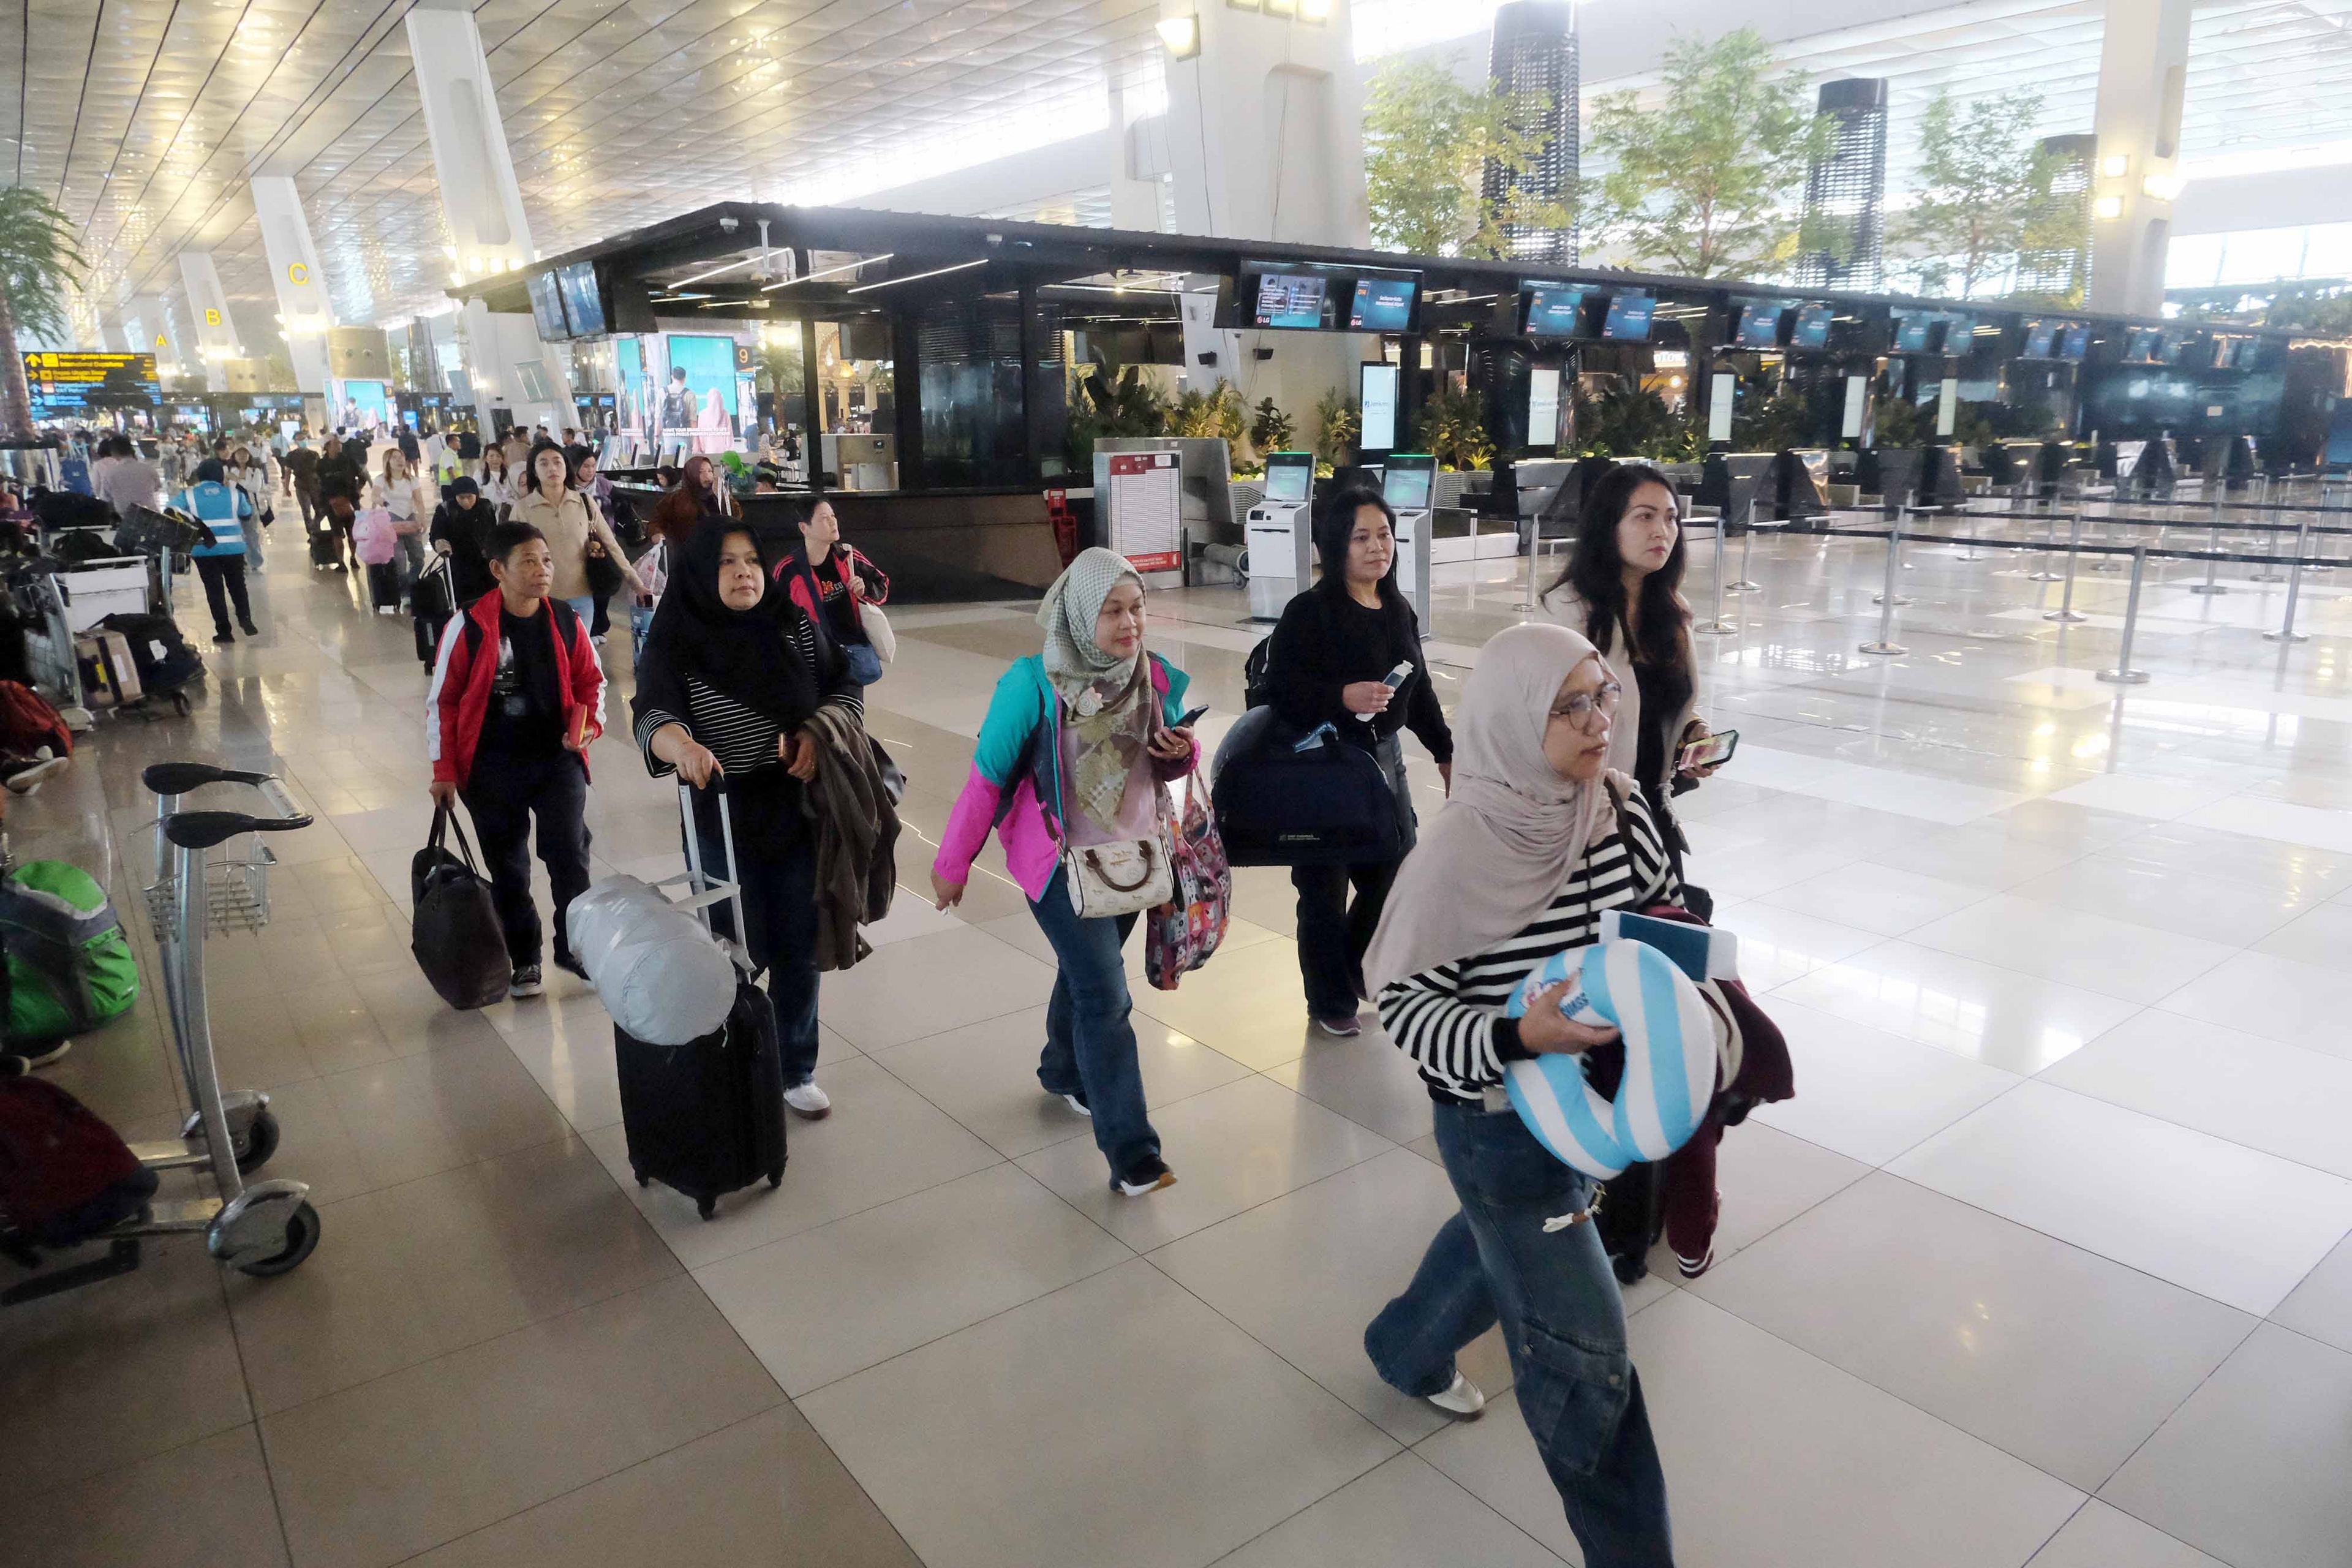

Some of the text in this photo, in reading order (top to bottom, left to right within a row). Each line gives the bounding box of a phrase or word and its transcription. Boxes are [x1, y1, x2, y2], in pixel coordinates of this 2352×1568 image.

[288, 263, 309, 285] C
[206, 309, 222, 326] B
[156, 334, 167, 347] A
[739, 349, 748, 364] 9
